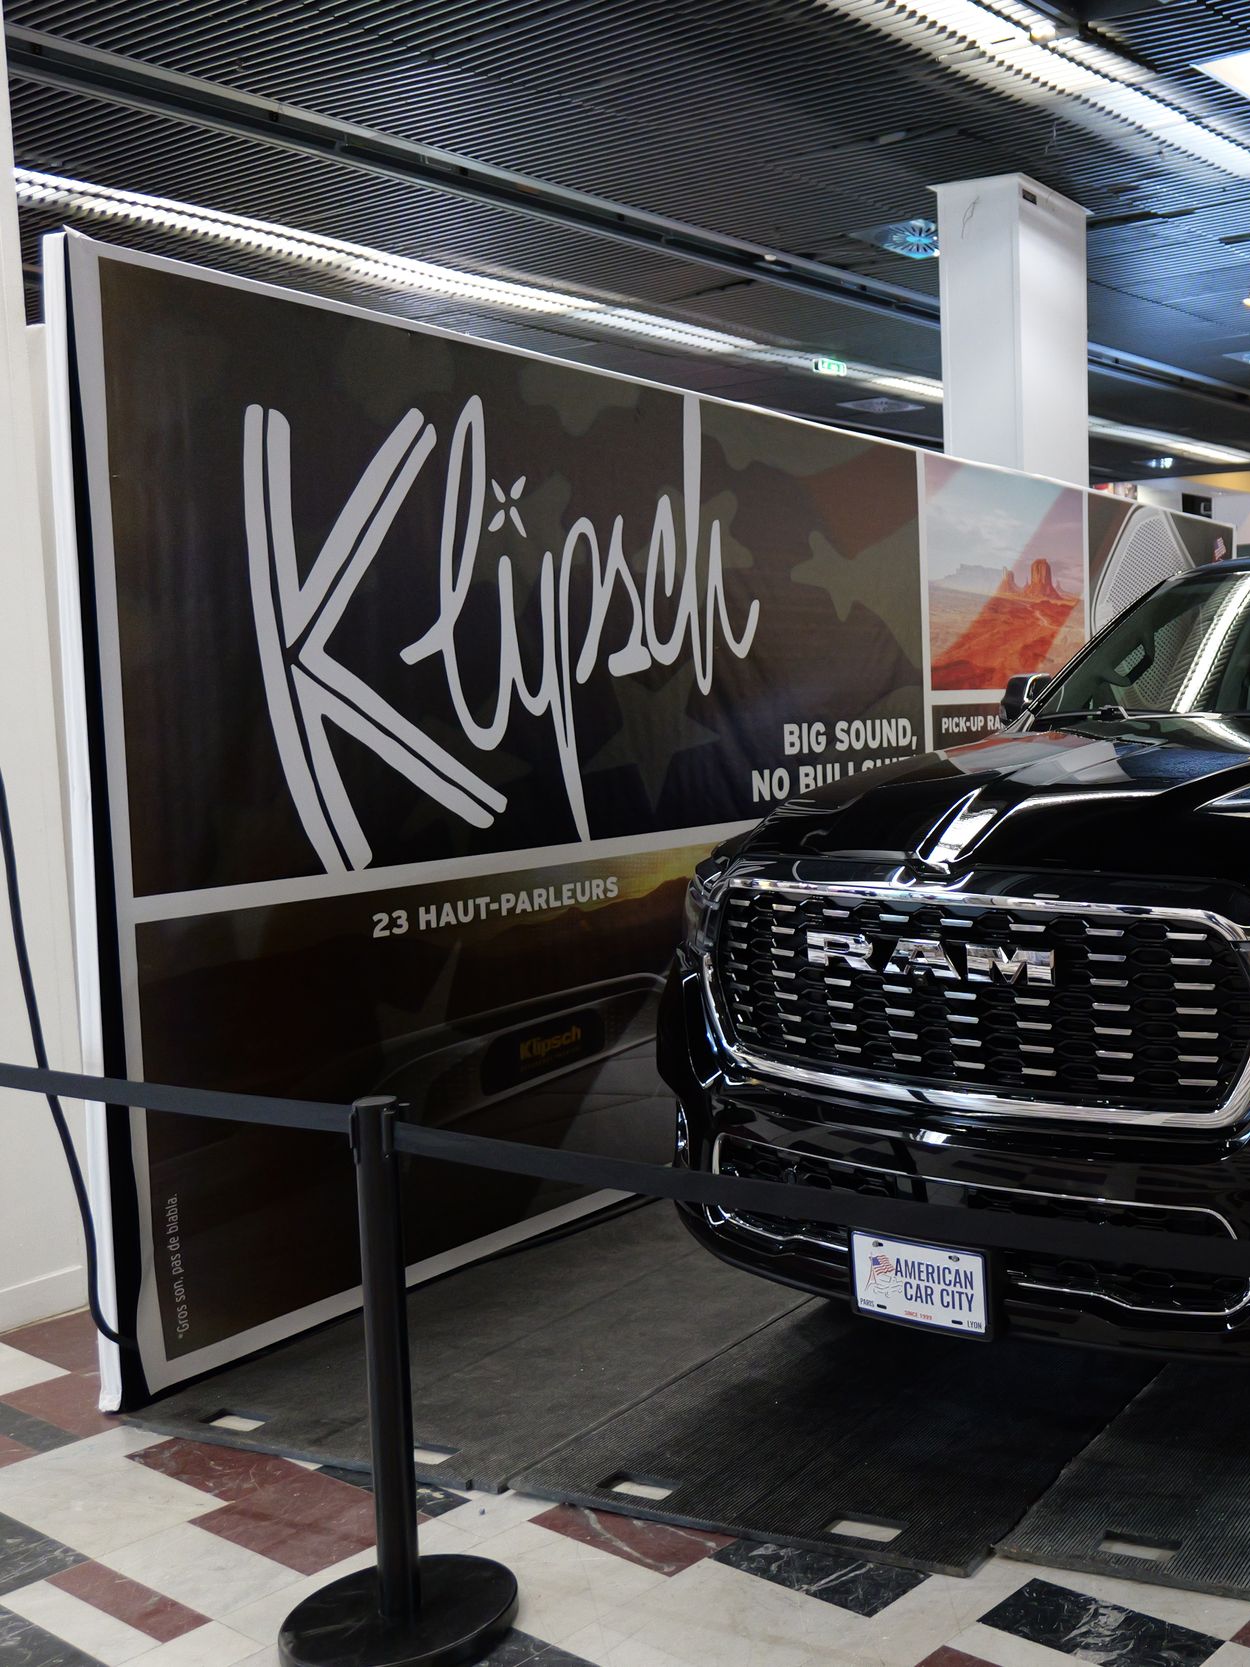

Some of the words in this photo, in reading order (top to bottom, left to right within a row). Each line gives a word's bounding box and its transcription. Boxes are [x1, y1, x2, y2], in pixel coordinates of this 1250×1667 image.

[244, 394, 761, 873] Klipsch
[784, 722, 827, 756] BIG
[835, 718, 917, 752] SOUND,
[941, 715, 985, 734] PICK-UP
[987, 714, 1004, 731] RA
[751, 767, 791, 802] NO
[372, 909, 410, 939] 23
[418, 876, 620, 931] HAUT-PARLEURS
[807, 929, 1056, 987] RAM
[518, 1024, 583, 1062] Klipsch
[164, 1193, 180, 1235] blabla.
[166, 1235, 181, 1251] de
[170, 1253, 185, 1276] pas
[894, 1257, 975, 1291] AMERICAN
[860, 1297, 875, 1308] PARIS
[903, 1281, 935, 1306] CAR
[940, 1288, 975, 1313] CITY
[904, 1309, 918, 1318] SINCE
[966, 1320, 983, 1330] LYON
